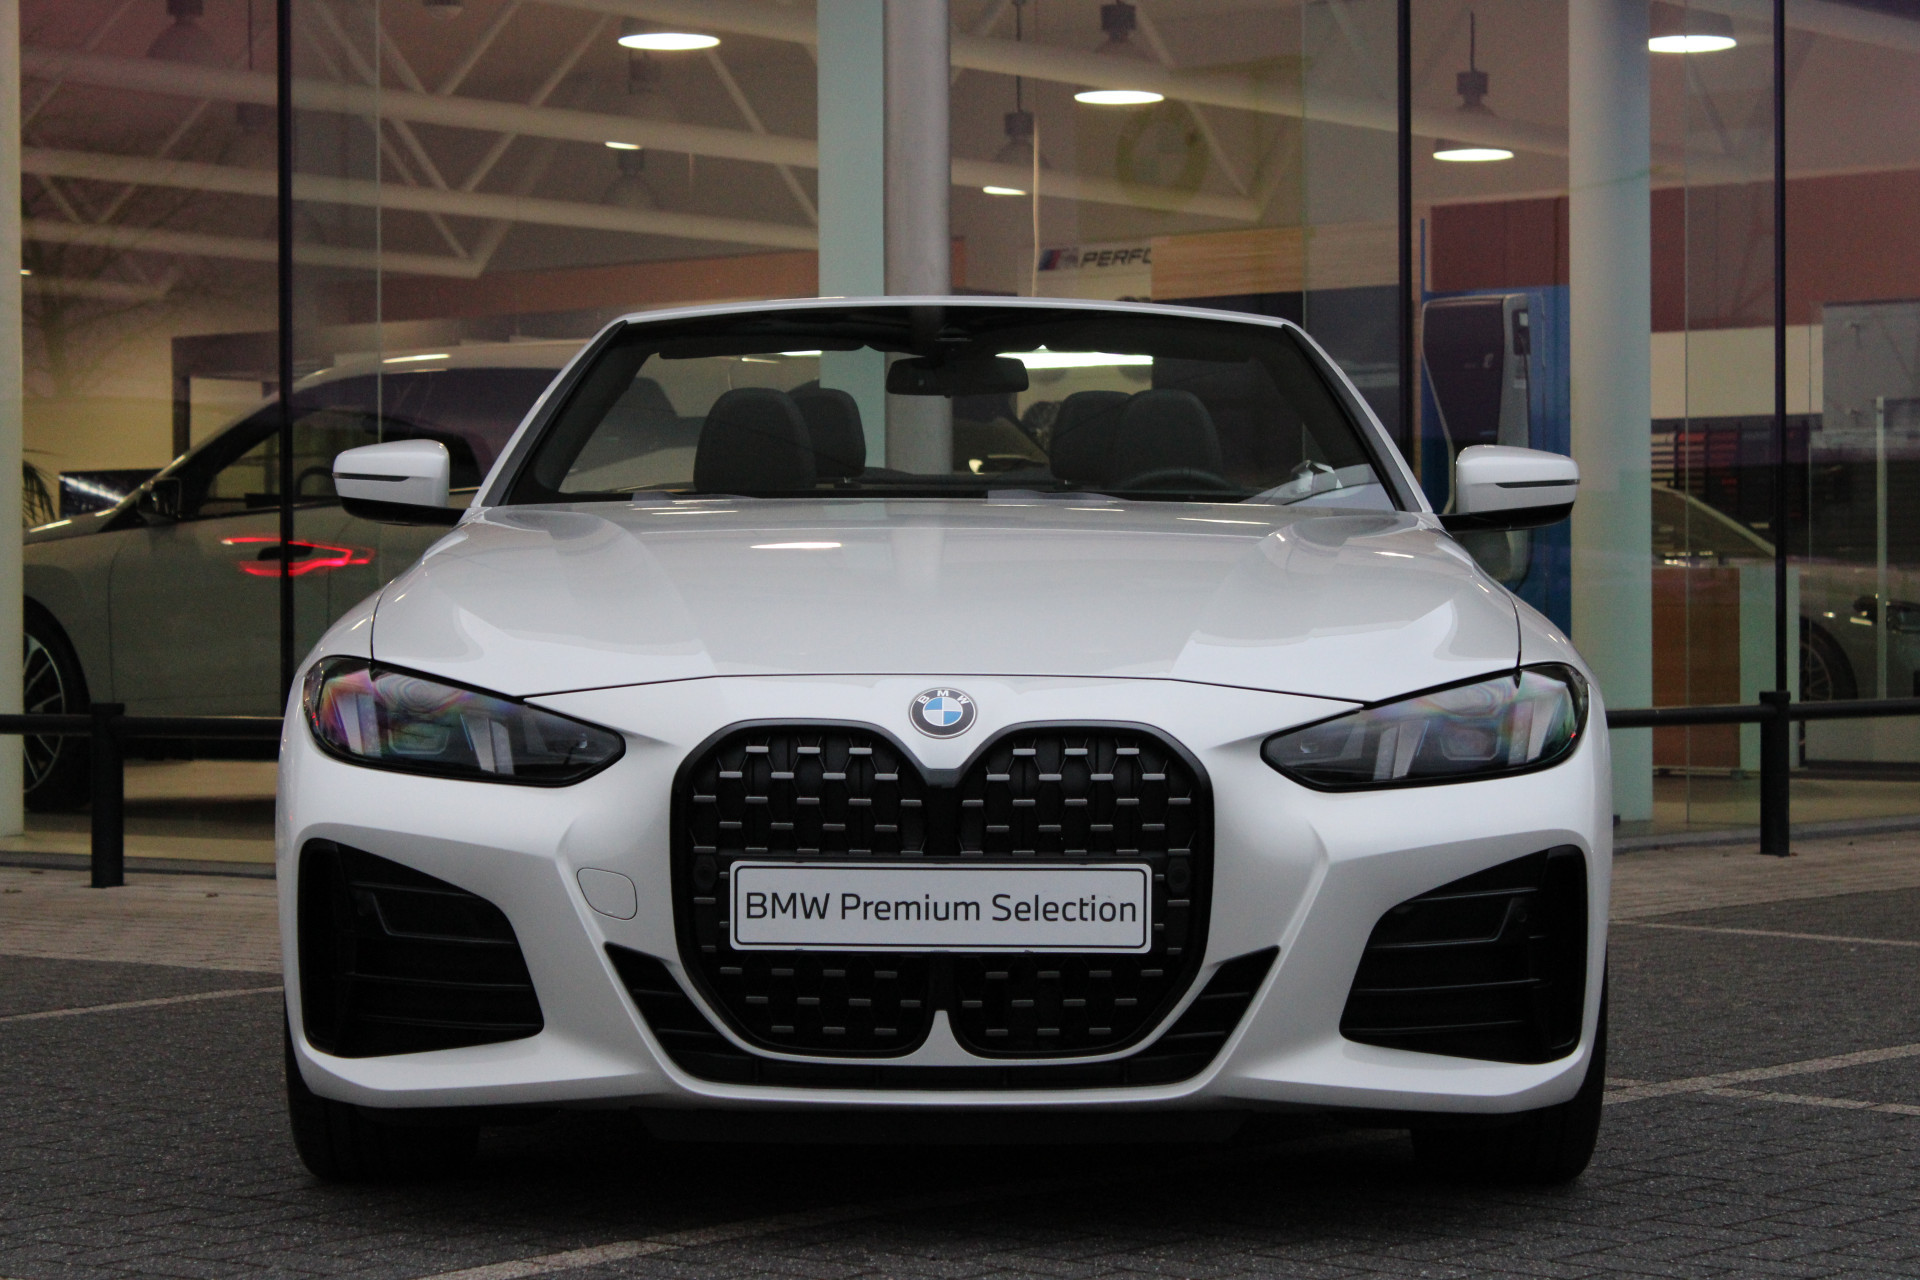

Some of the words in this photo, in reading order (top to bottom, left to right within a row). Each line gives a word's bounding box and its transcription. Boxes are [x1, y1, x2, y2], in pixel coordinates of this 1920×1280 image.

[917, 690, 970, 705] BMW
[746, 892, 830, 920] BMW
[841, 893, 980, 921] Premium
[991, 893, 1136, 922] Selection
